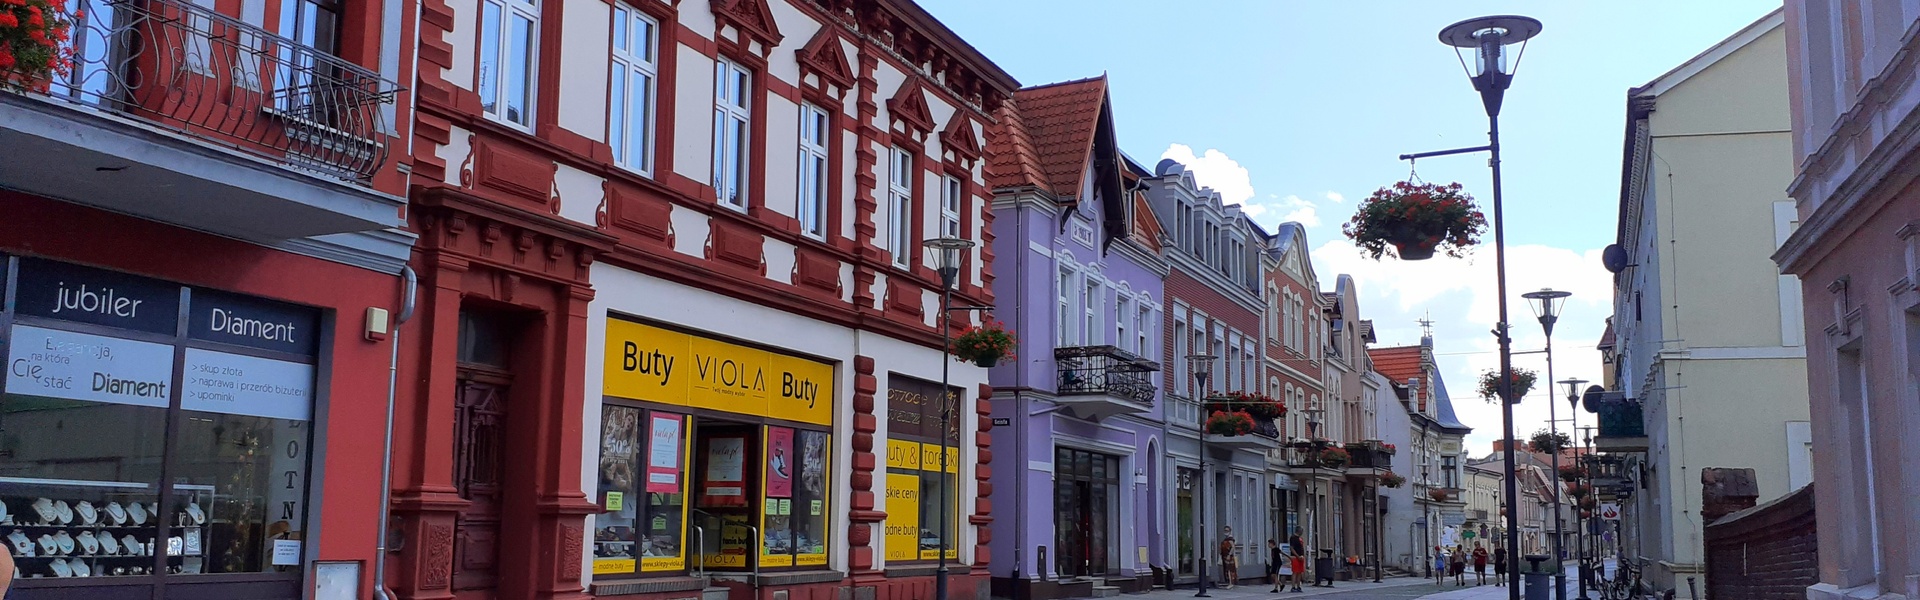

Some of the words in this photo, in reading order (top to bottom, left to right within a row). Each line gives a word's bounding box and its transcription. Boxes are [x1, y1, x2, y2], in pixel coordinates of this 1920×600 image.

[52, 281, 142, 318] jubiler
[211, 308, 296, 343] Diament
[31, 352, 42, 361] na
[623, 340, 674, 386] Buty
[13, 359, 43, 383] Cię
[44, 376, 72, 390] stać
[200, 364, 219, 375] skup
[222, 367, 243, 377] złota
[696, 354, 765, 392] VIOLA
[92, 372, 166, 399] Diament
[197, 391, 235, 402] upominki
[198, 377, 234, 389] naprawa
[236, 380, 239, 389] i
[240, 382, 274, 394] przerób
[782, 371, 818, 409] Buty
[909, 446, 918, 465] &
[902, 489, 918, 502] ceny
[903, 524, 918, 538] buty
